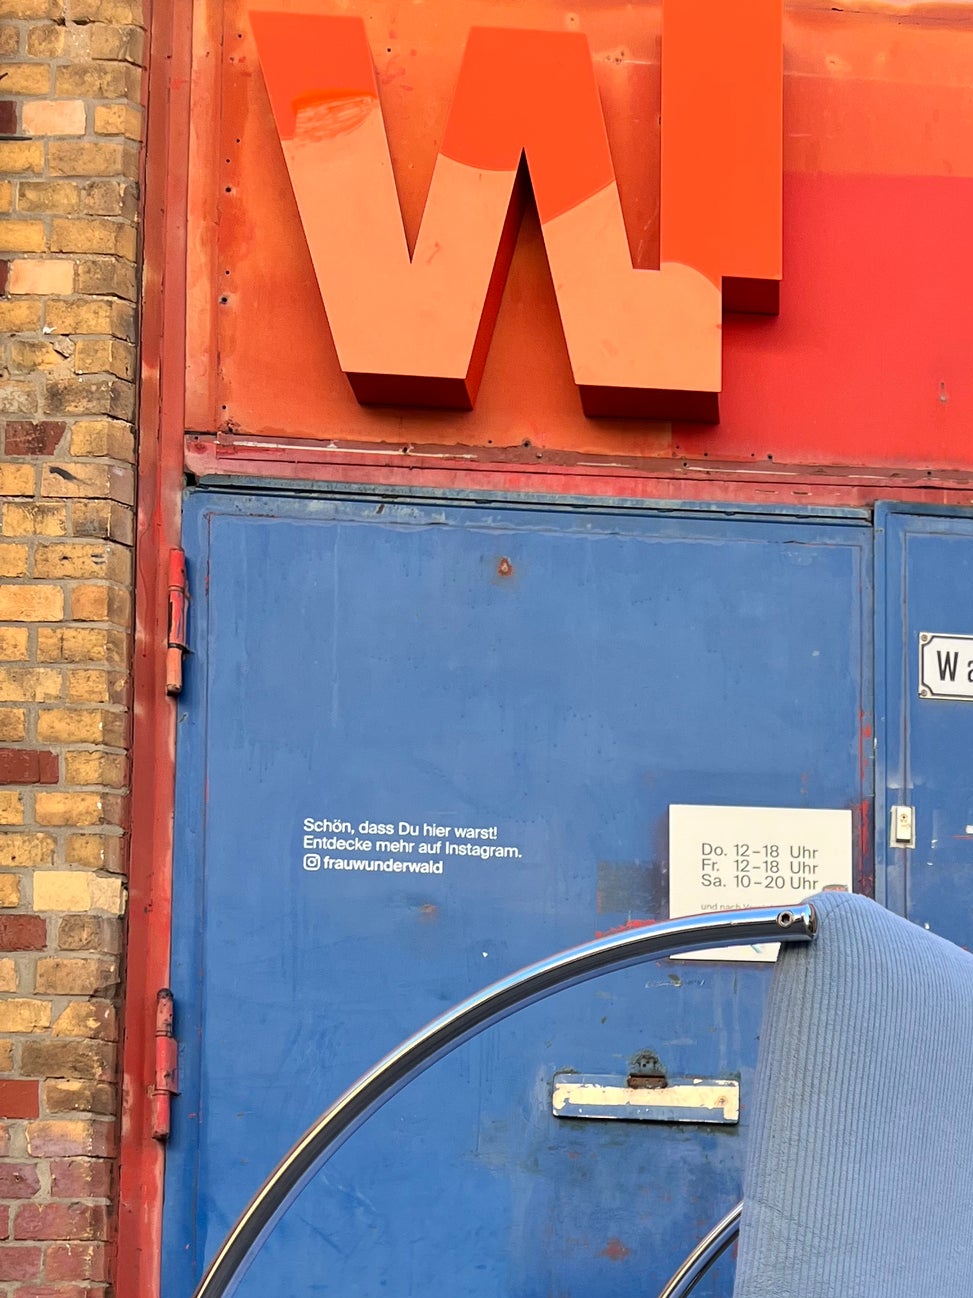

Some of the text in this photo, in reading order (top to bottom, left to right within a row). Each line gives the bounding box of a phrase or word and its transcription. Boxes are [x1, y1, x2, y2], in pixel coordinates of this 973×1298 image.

[303, 817, 498, 840] Schön, dass Du hier warst!
[303, 835, 523, 859] Entdecke mehr auf Instagram.
[701, 842, 728, 857] Do.
[790, 846, 819, 859] Uhr
[323, 856, 444, 874] frauwunderwald
[701, 858, 720, 872] Fr.
[790, 861, 819, 875] Uhr
[701, 874, 727, 888] Sa.
[790, 877, 819, 890] Uhr
[700, 902, 718, 911] und
